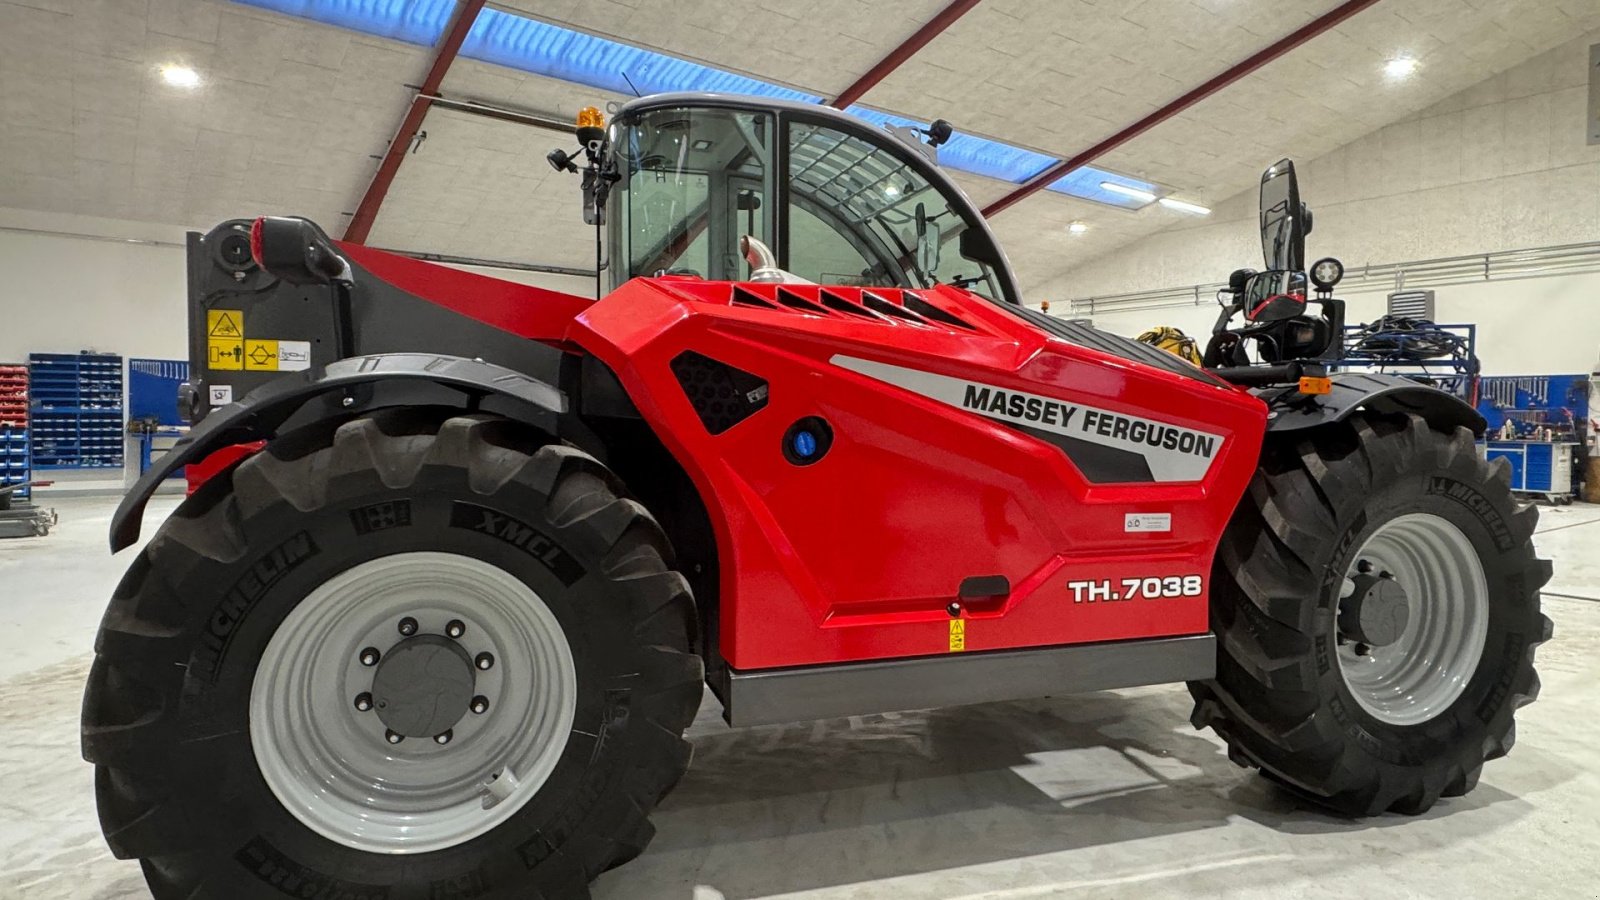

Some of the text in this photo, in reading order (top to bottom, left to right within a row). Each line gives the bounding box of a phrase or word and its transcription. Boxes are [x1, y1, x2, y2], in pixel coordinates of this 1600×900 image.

[963, 384, 1214, 458] MASSEY FERGUSON
[473, 509, 562, 569] XMCL
[1447, 481, 1515, 549] MICHELIN
[1068, 575, 1202, 603] TH.7038
